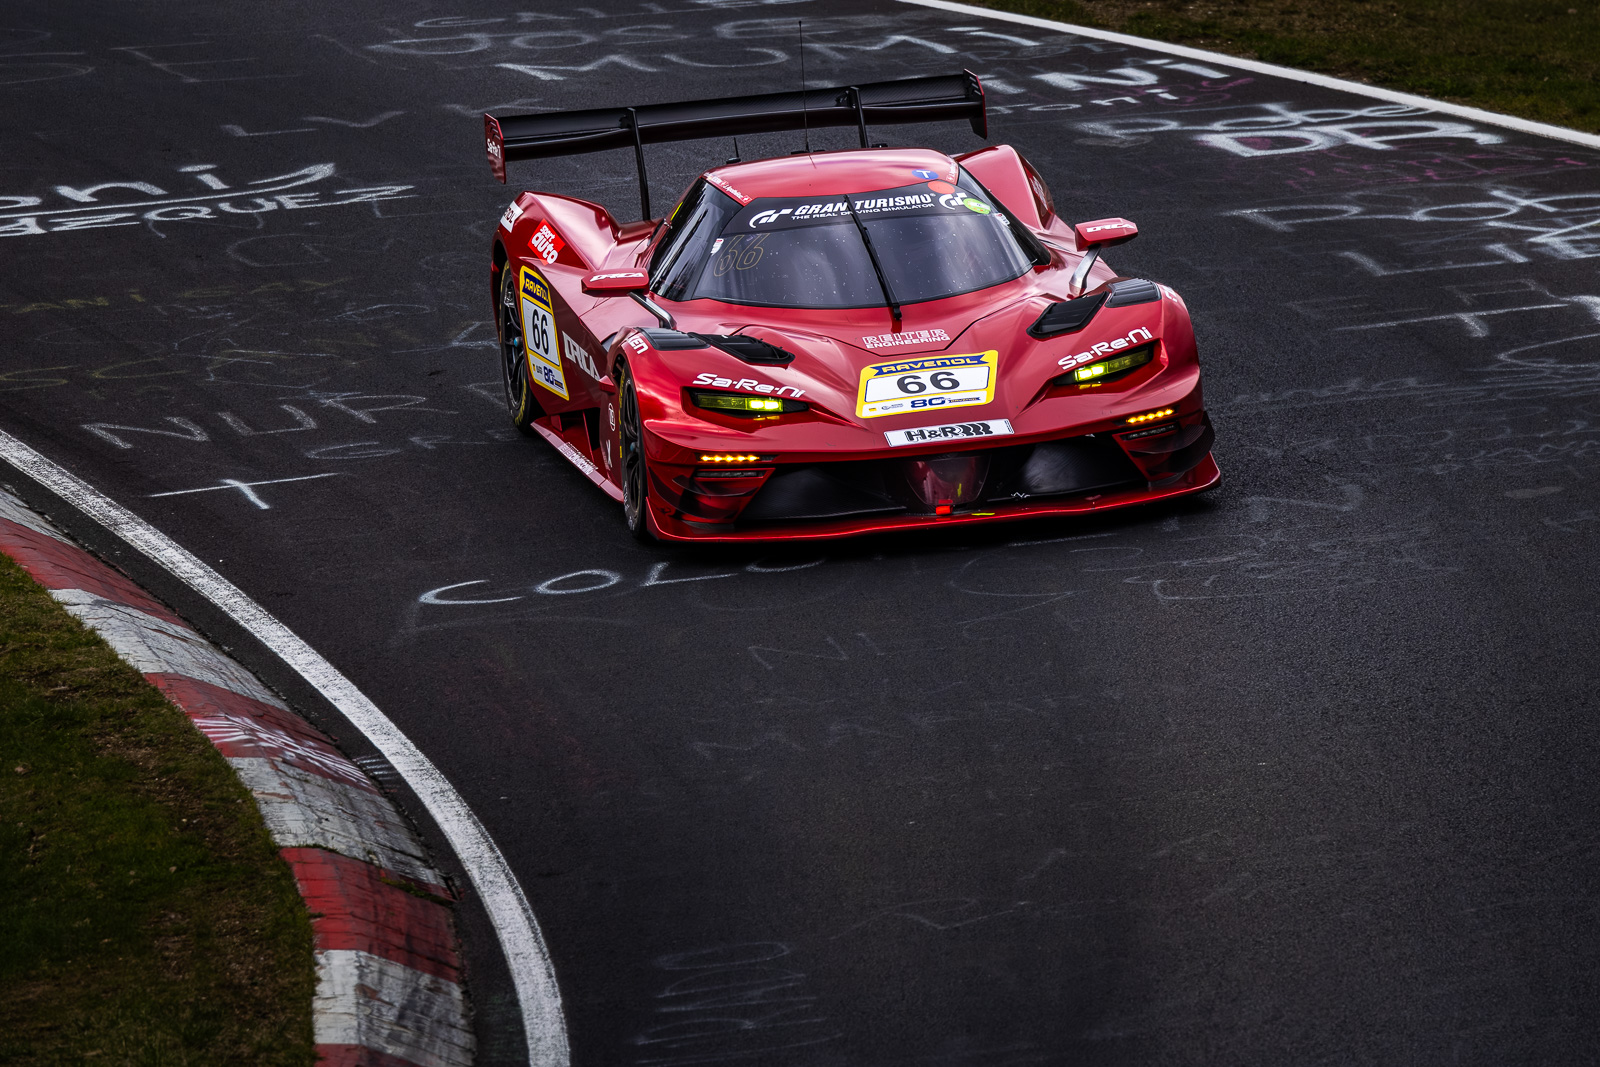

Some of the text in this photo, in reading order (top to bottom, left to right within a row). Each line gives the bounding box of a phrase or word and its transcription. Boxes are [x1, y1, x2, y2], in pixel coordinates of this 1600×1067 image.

[794, 202, 848, 216] GRAN
[841, 208, 881, 216] DRVING
[882, 203, 935, 213] SIMULATOR
[531, 232, 559, 265] auto
[713, 232, 771, 278] 66
[525, 278, 550, 303] RAVENOL
[531, 308, 550, 355] 66
[862, 329, 948, 345] REITER
[866, 335, 951, 349] ENGINEERING
[881, 357, 979, 374] RAVENOL
[896, 371, 960, 395] 66
[904, 425, 958, 442] H&R
